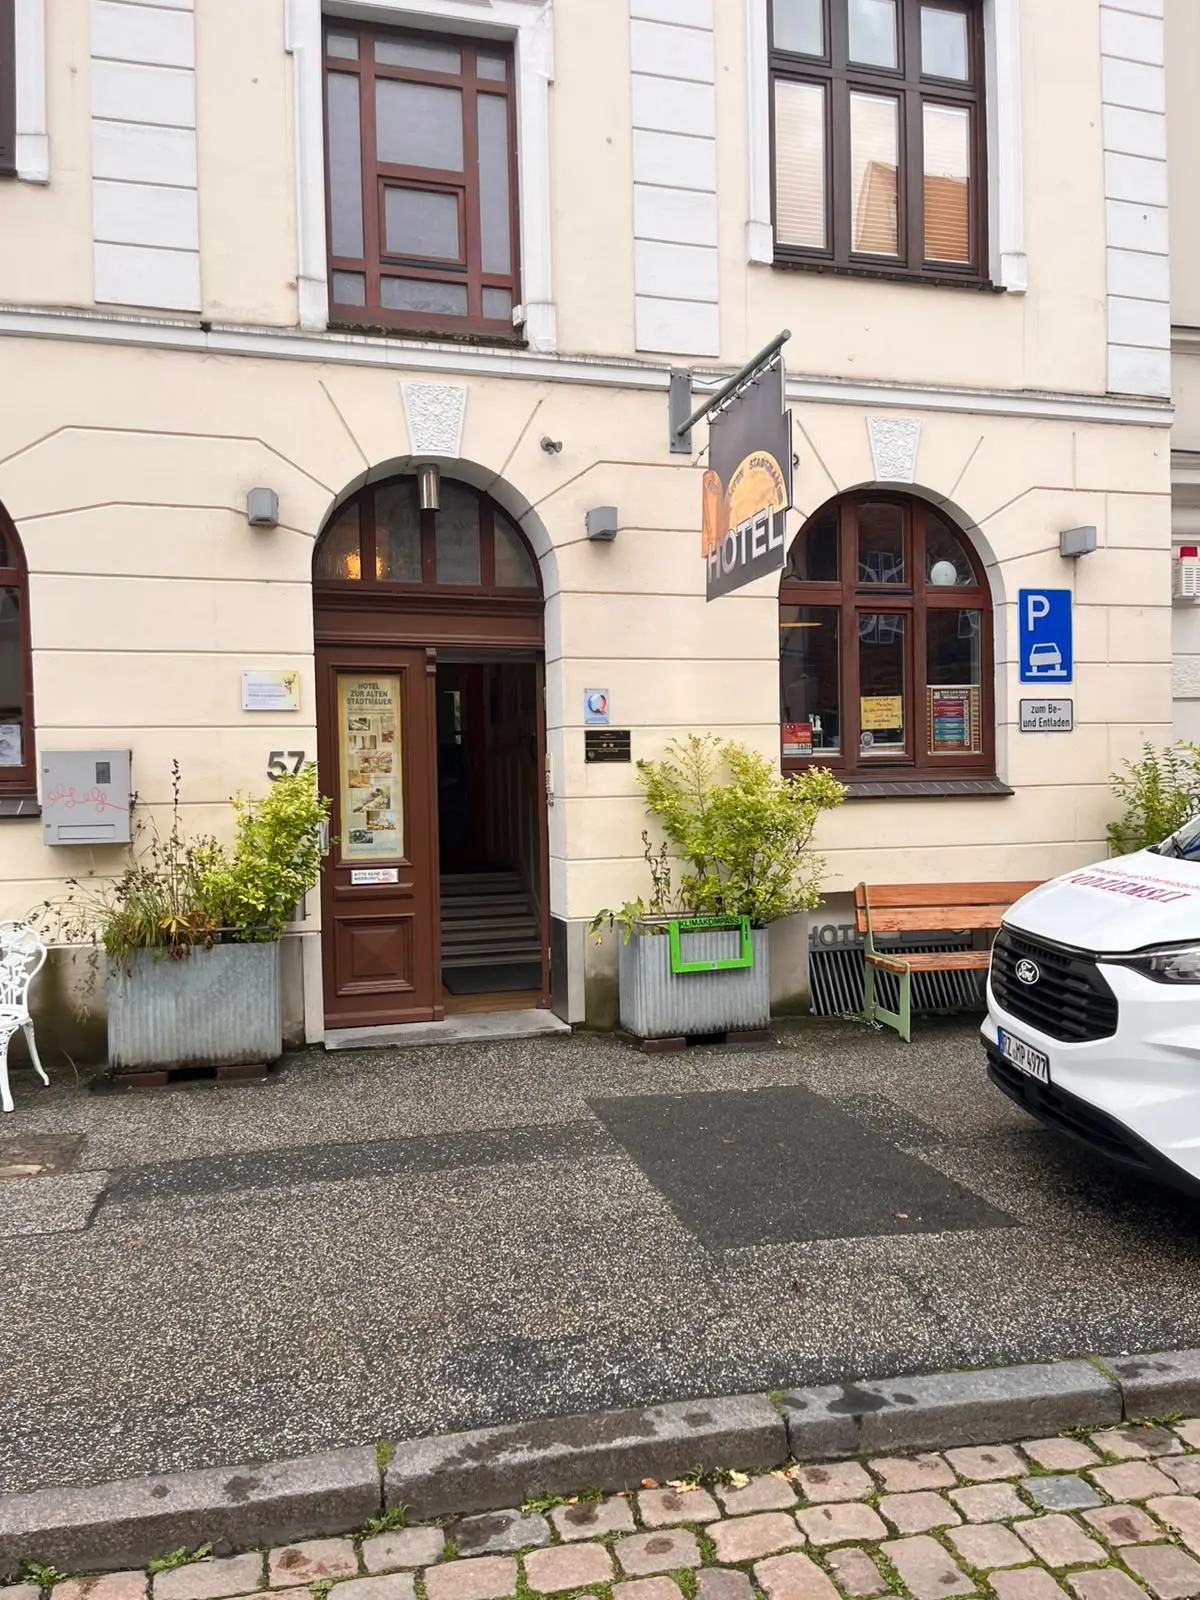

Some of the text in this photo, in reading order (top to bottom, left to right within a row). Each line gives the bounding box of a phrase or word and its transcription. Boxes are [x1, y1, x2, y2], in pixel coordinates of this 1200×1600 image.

[708, 504, 783, 583] HOTEL
[1027, 595, 1050, 631] P
[358, 682, 380, 690] HOTEL
[346, 697, 393, 705] STADTMAUER
[1031, 704, 1062, 714] zum Be-
[1023, 717, 1070, 728] und Entladen
[267, 751, 305, 782] 57
[679, 916, 741, 928] KLIMAKOMPASS
[1018, 961, 1036, 981] Ford
[1026, 1048, 1046, 1079] 4977
